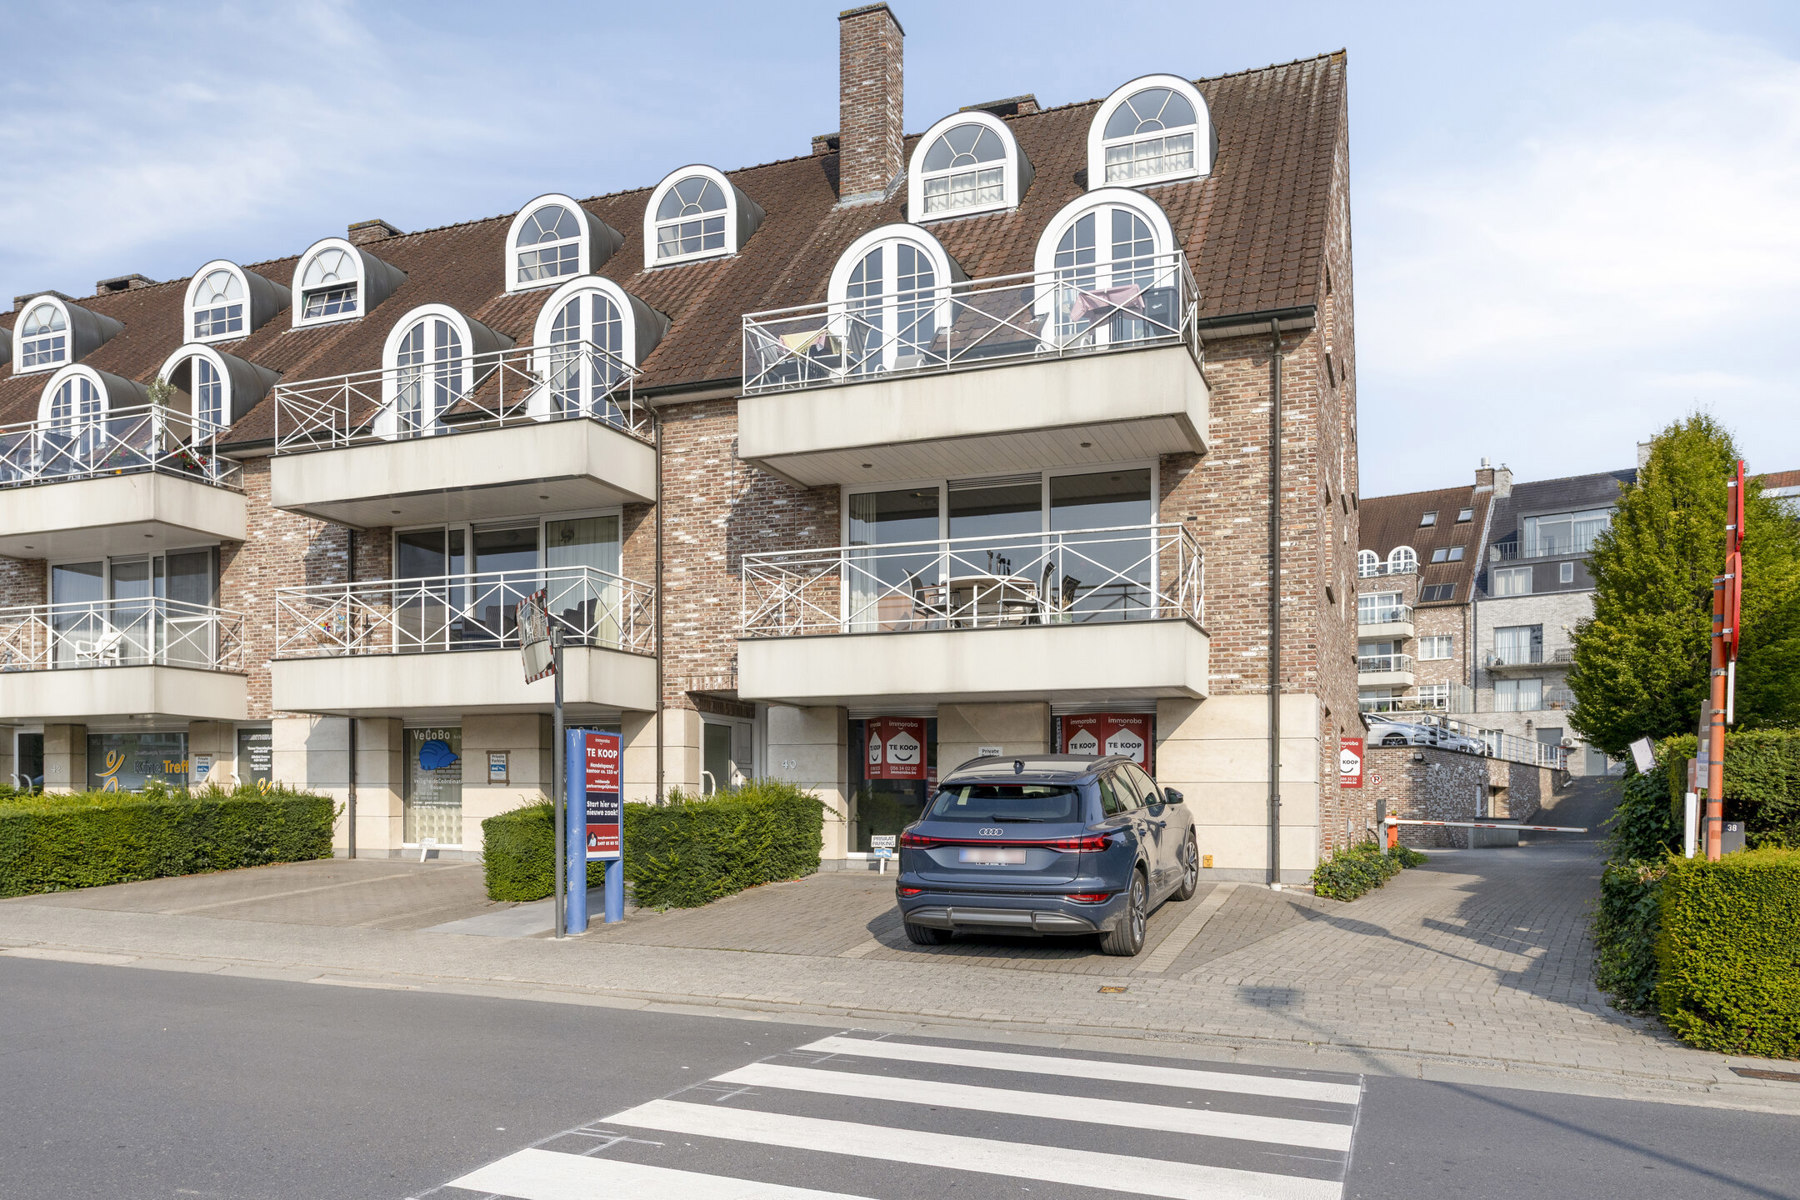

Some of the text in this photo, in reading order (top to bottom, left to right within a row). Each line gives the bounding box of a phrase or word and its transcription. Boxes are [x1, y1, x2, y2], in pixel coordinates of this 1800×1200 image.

[889, 720, 918, 728] immoroba
[1070, 717, 1097, 725] immoroba
[1108, 716, 1142, 724] immoroba
[413, 729, 450, 740] VeCoBo
[586, 747, 618, 759] TE KOOP
[781, 759, 797, 769] 40
[586, 800, 599, 808] Start
[600, 800, 609, 808] hier
[586, 808, 604, 816] nieuwe
[1727, 823, 1738, 832] 38
